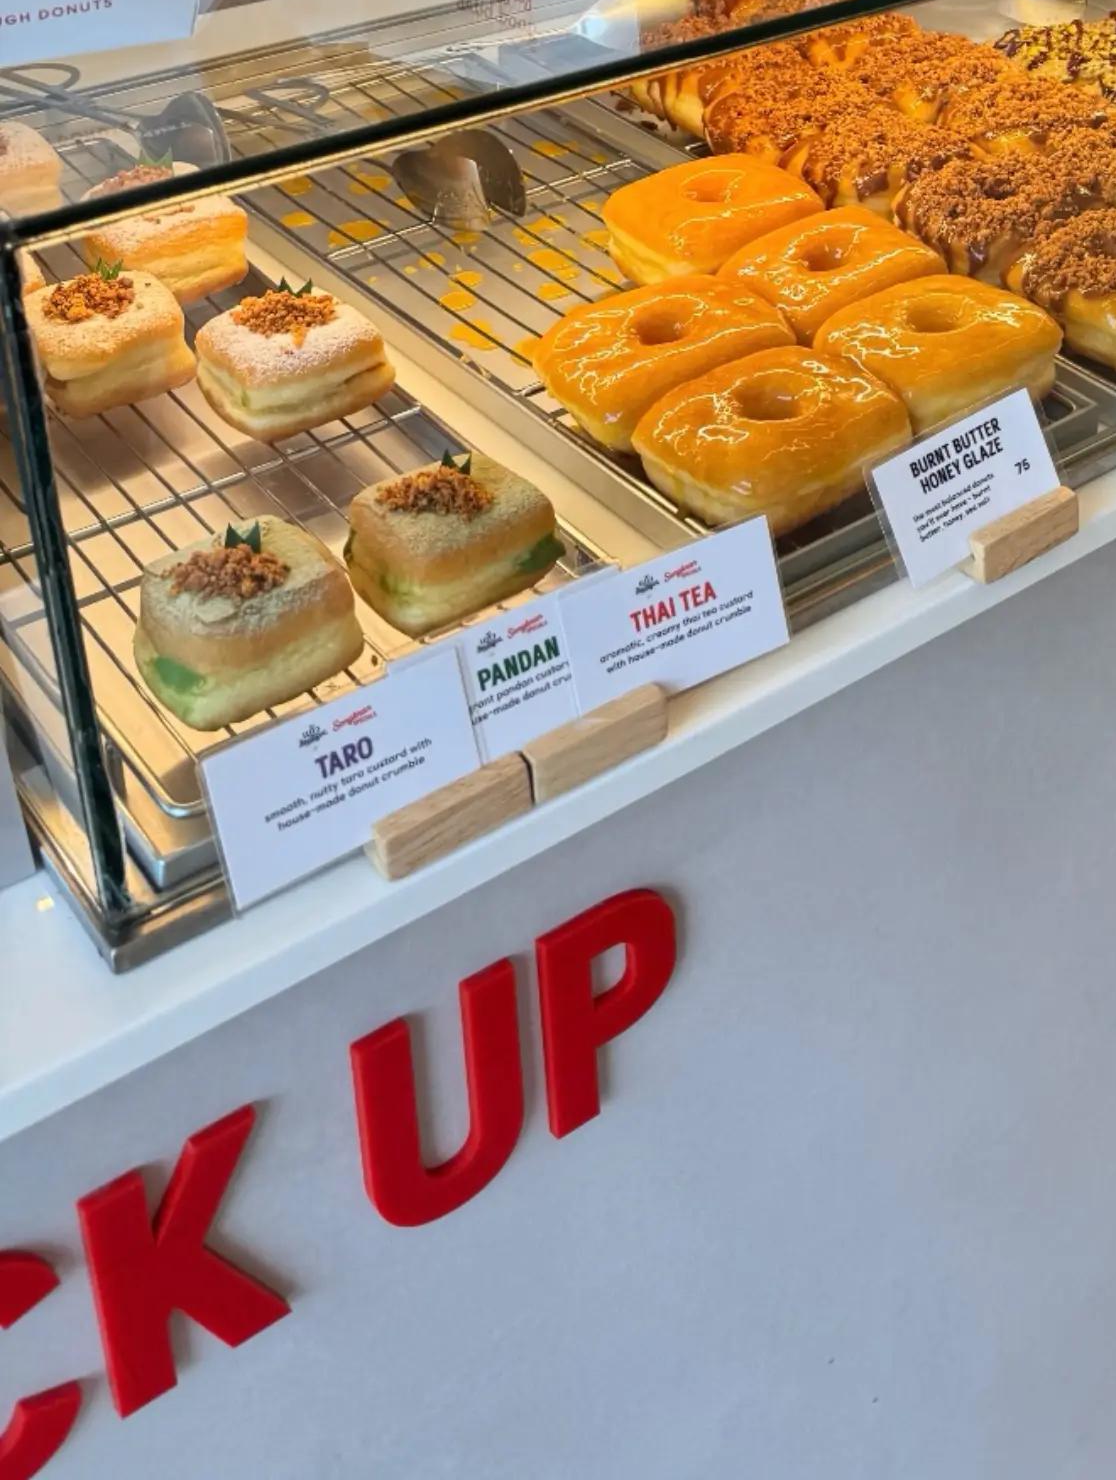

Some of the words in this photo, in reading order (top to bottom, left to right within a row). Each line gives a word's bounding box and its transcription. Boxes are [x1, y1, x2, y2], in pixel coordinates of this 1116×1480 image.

[909, 443, 952, 479] BURNT
[952, 417, 1002, 454] BUTTER
[919, 463, 962, 495] HONEY
[963, 437, 1004, 471] GLAZE
[1014, 458, 1031, 475] 75
[600, 639, 645, 664] aromatic,
[646, 622, 681, 643] creamy
[682, 613, 701, 627] thai
[702, 607, 718, 618] tea
[719, 590, 754, 611] custard
[629, 596, 677, 633] THAI
[678, 580, 717, 612] TEA
[477, 635, 560, 692] PANDAN
[606, 659, 627, 673] with
[628, 632, 685, 665] house-made
[686, 621, 714, 638] donut
[714, 605, 752, 626] crumble
[496, 677, 534, 701] pandan
[522, 682, 551, 701] donut
[264, 798, 308, 823] smooth,
[309, 783, 339, 801] nutty
[340, 770, 365, 786] taro
[366, 748, 408, 774] custard
[409, 736, 433, 753] with
[314, 735, 374, 780] TARO
[276, 792, 346, 832] house-made
[347, 776, 380, 798] donut
[381, 755, 426, 782] crumble
[350, 887, 677, 1228] UP
